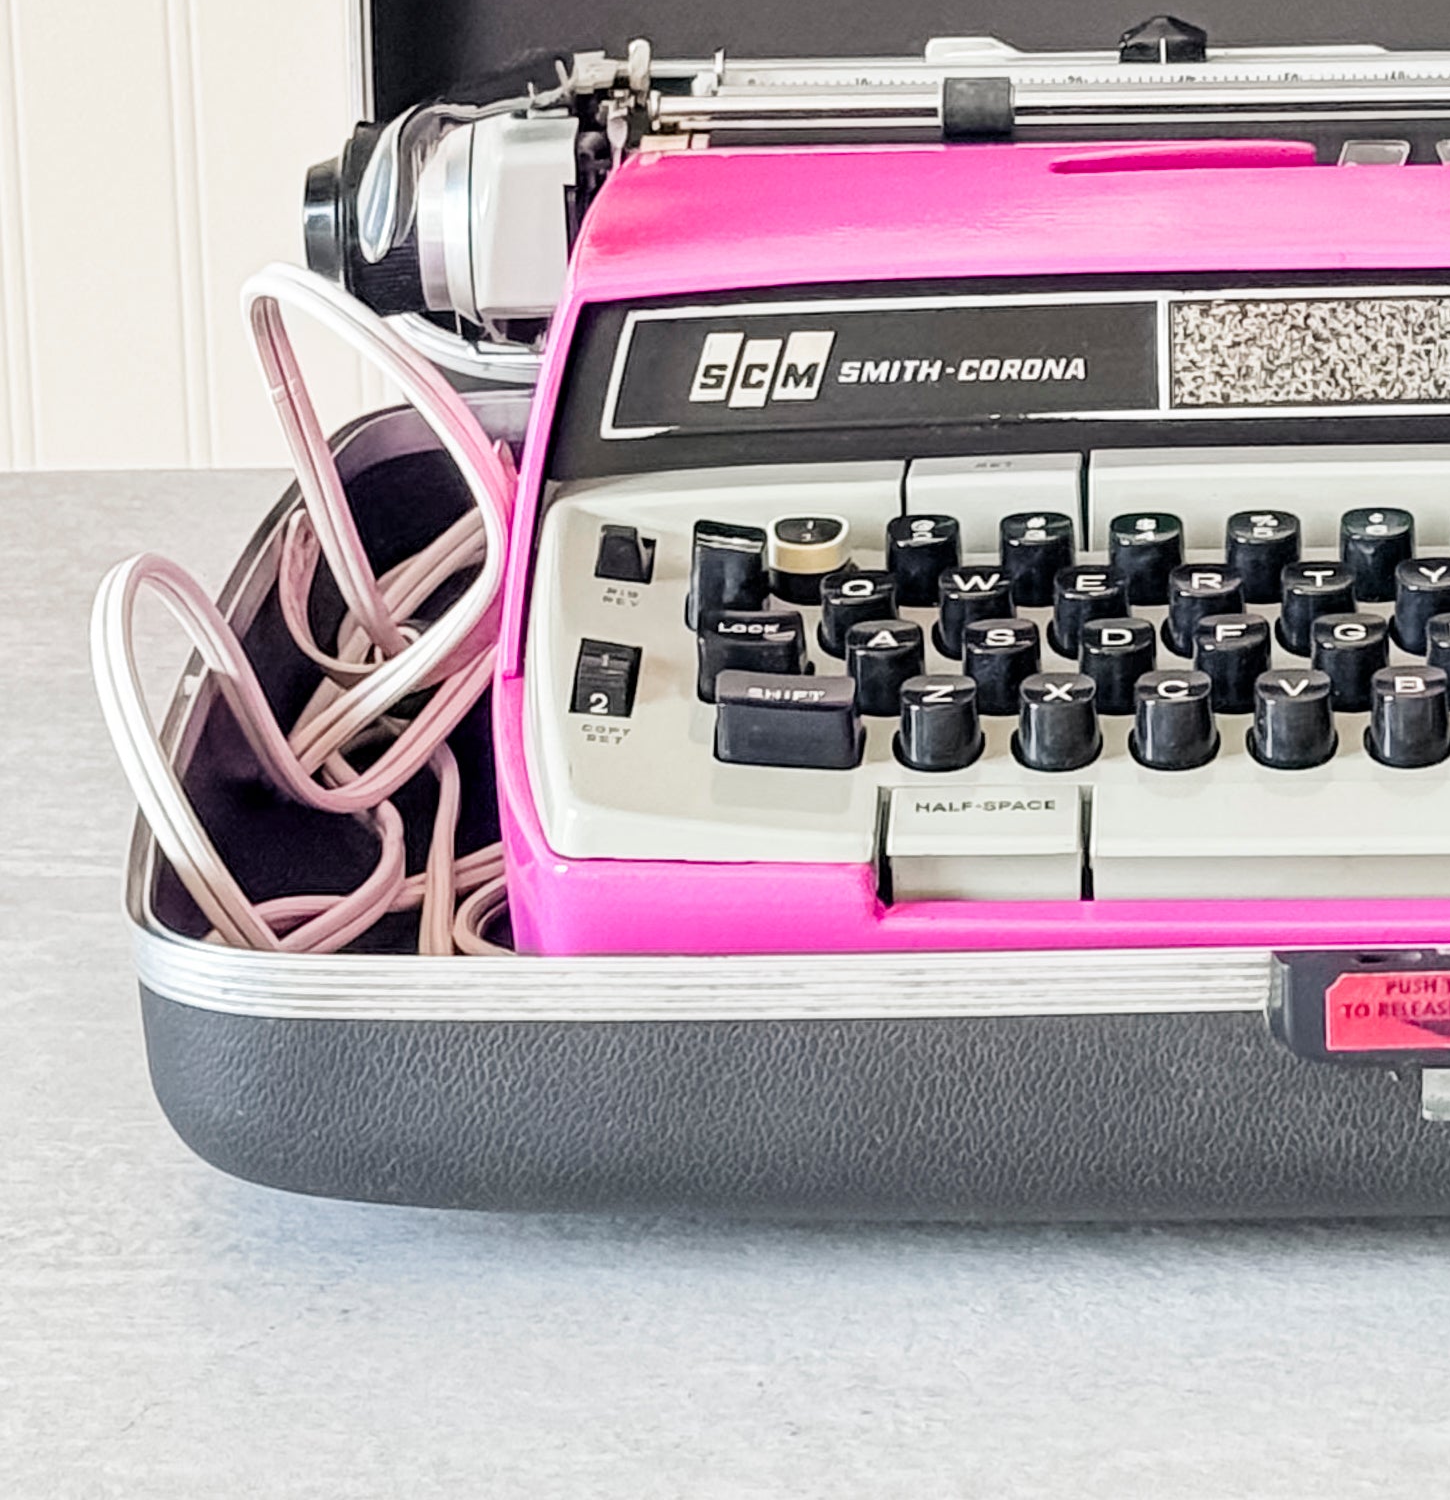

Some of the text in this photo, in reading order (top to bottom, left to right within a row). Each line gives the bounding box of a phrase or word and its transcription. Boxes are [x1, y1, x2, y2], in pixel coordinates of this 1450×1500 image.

[837, 355, 1088, 385] SMITH-CORONA
[951, 573, 1001, 592] W
[1075, 574, 1107, 593] E
[1190, 571, 1223, 590] R
[1302, 569, 1335, 588] T
[1418, 565, 1448, 584] Y
[841, 579, 875, 597] Q
[866, 629, 899, 648] A
[985, 628, 1017, 647] S
[1100, 627, 1133, 647] D
[1214, 623, 1248, 642] F
[1332, 623, 1368, 642] G
[920, 684, 955, 703] Z
[1041, 682, 1074, 702] X
[1156, 679, 1190, 698] C
[1277, 678, 1311, 698] V
[1393, 676, 1427, 694] B
[588, 691, 609, 715] 2
[915, 799, 1056, 814] HALF-SPACE
[1386, 978, 1437, 995] PUSH
[1342, 1003, 1370, 1020] TO
